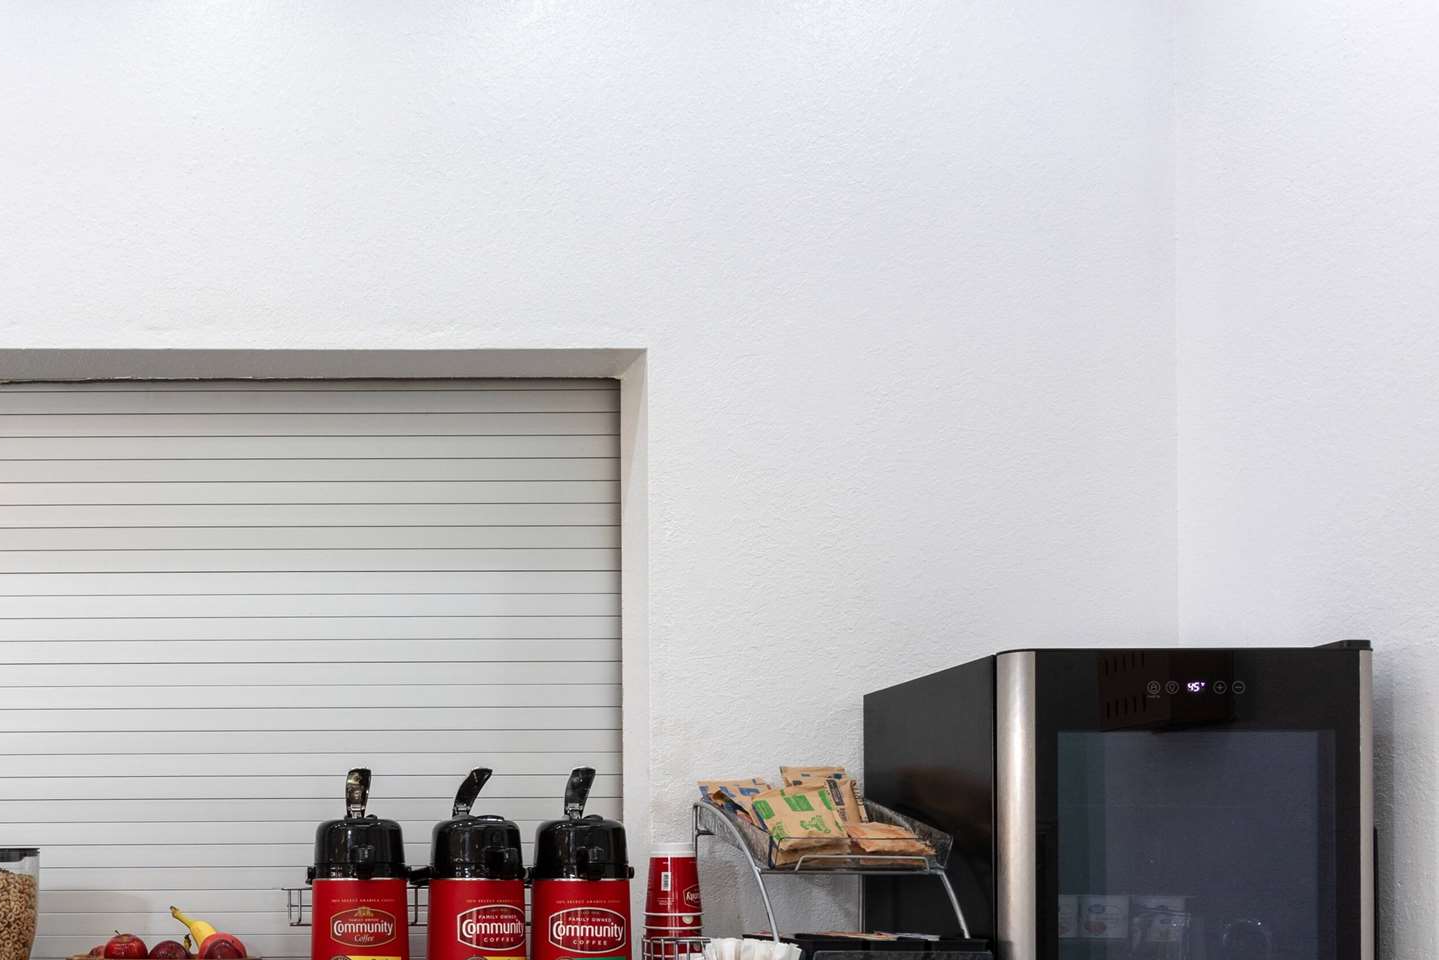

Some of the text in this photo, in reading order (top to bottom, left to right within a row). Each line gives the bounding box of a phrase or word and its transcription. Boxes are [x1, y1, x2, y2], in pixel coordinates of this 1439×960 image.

[333, 919, 394, 936] Community
[462, 919, 525, 938] Community
[552, 921, 623, 941] Community
